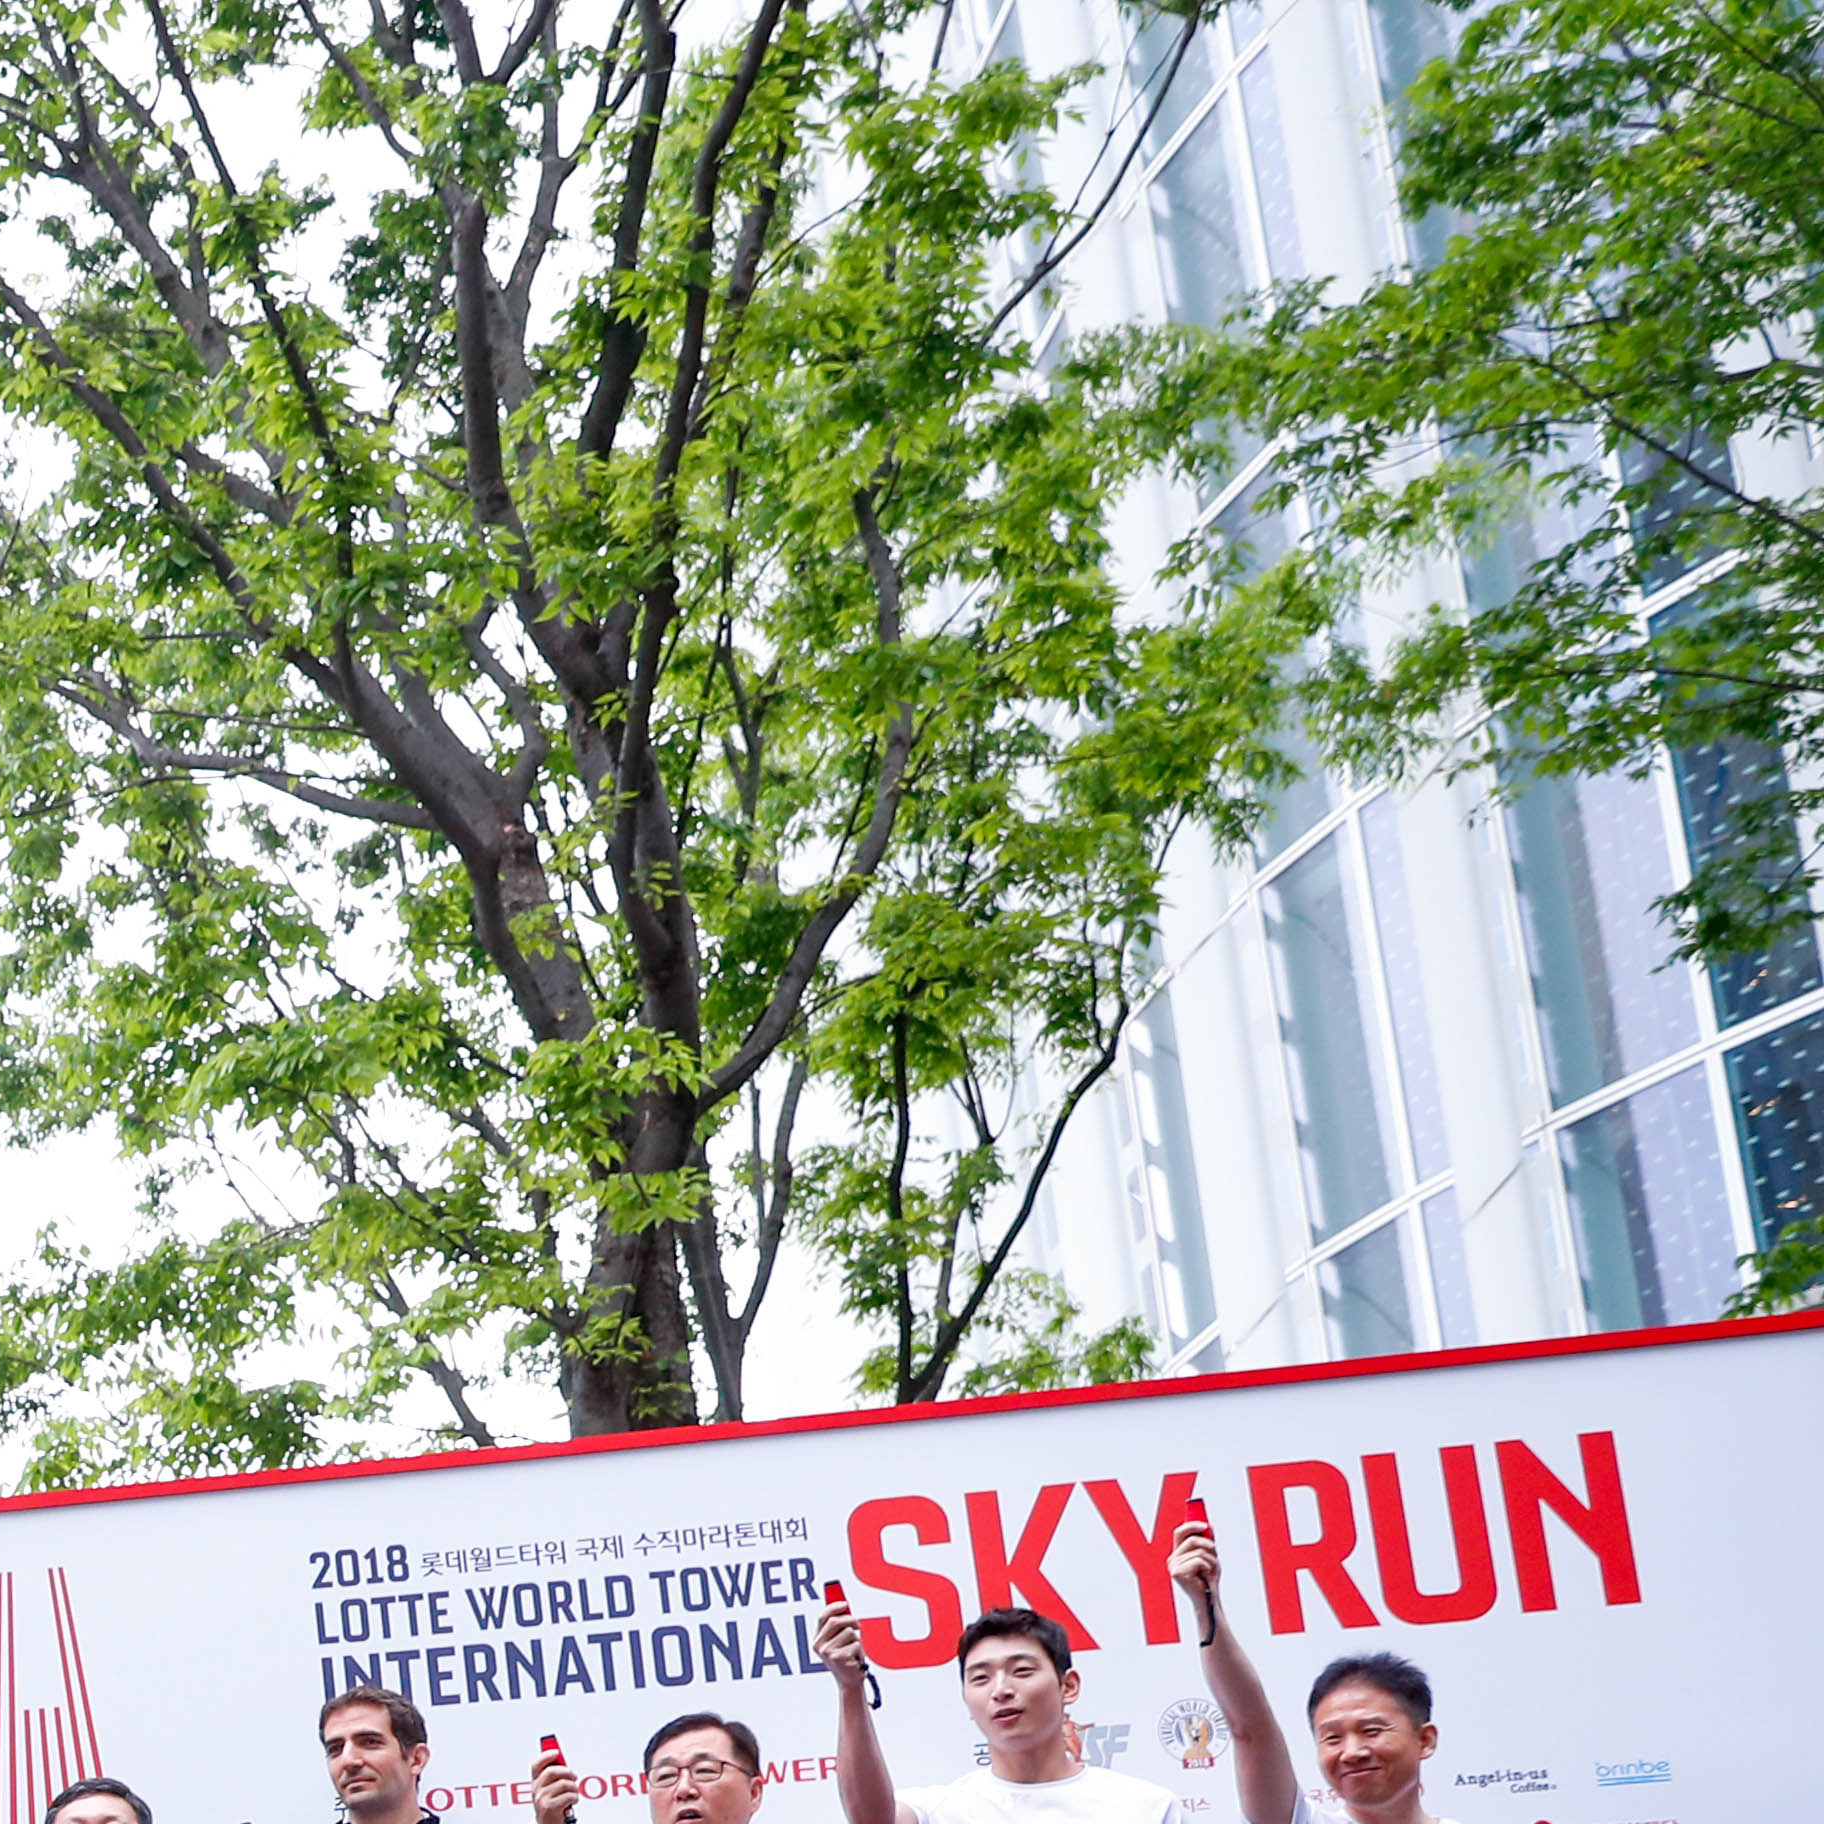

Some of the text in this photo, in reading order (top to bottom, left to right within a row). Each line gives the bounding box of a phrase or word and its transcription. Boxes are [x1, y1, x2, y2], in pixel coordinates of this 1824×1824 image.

[309, 1516, 808, 1589] 2018 롯데월드타워 국제 수직마라톤대회
[846, 1430, 1643, 1671] SKY RUN
[314, 1557, 820, 1645] LOTTE WORLD TOWER
[321, 1614, 834, 1707] INTERNATIONAL
[425, 1756, 840, 1813] OTTE ORL WER
[1454, 1768, 1548, 1788] Angel-in-us
[1510, 1782, 1550, 1794] Coffee
